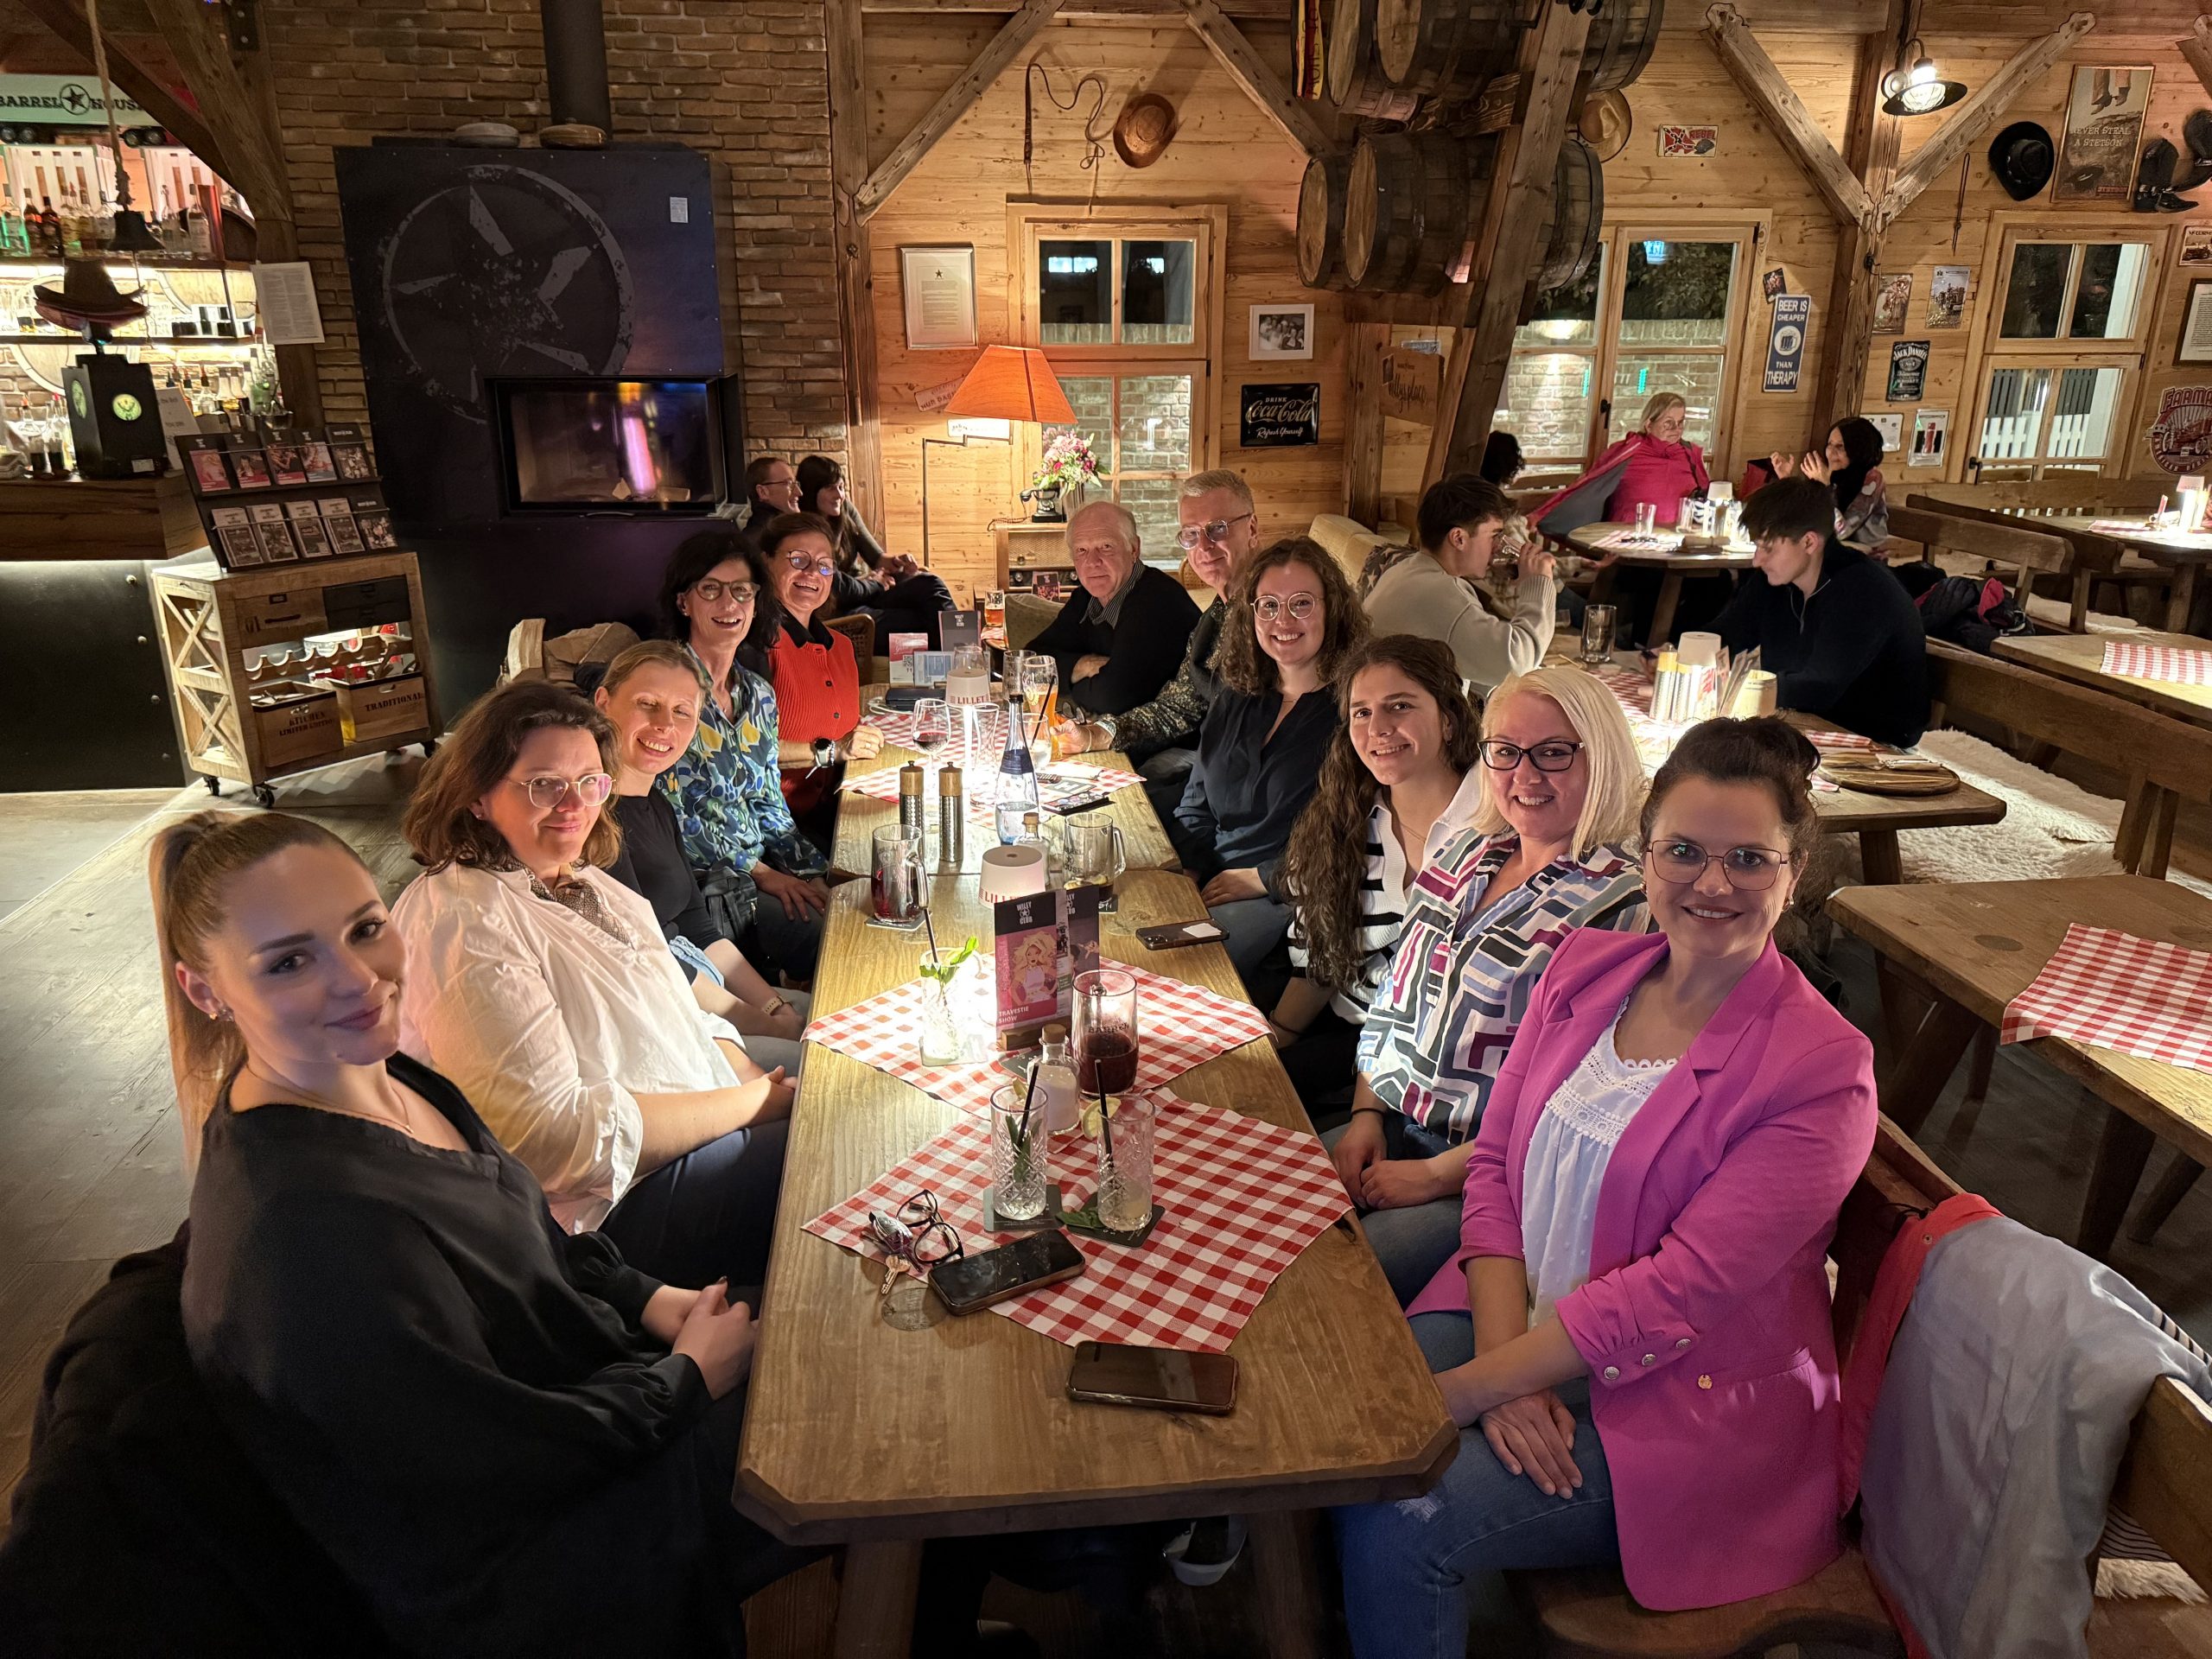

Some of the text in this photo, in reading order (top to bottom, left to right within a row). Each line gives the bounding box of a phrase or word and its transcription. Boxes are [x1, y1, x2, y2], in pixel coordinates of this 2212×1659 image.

[2102, 126, 2132, 135] STEAL
[2074, 138, 2123, 147] A STETSON
[1778, 299, 1808, 312] BEER IS
[1893, 348, 1908, 361] JACK
[1767, 371, 1798, 385] THERAPY
[1245, 398, 1314, 423] Coca-Cola
[1255, 426, 1303, 439] Refresh Yourself
[365, 692, 422, 712] TRADITIONAL
[1016, 901, 1032, 912] WILEY
[1020, 916, 1033, 925] CLUB
[999, 1006, 1030, 1017] TRAVESTIE
[999, 1015, 1018, 1025] SHOW
